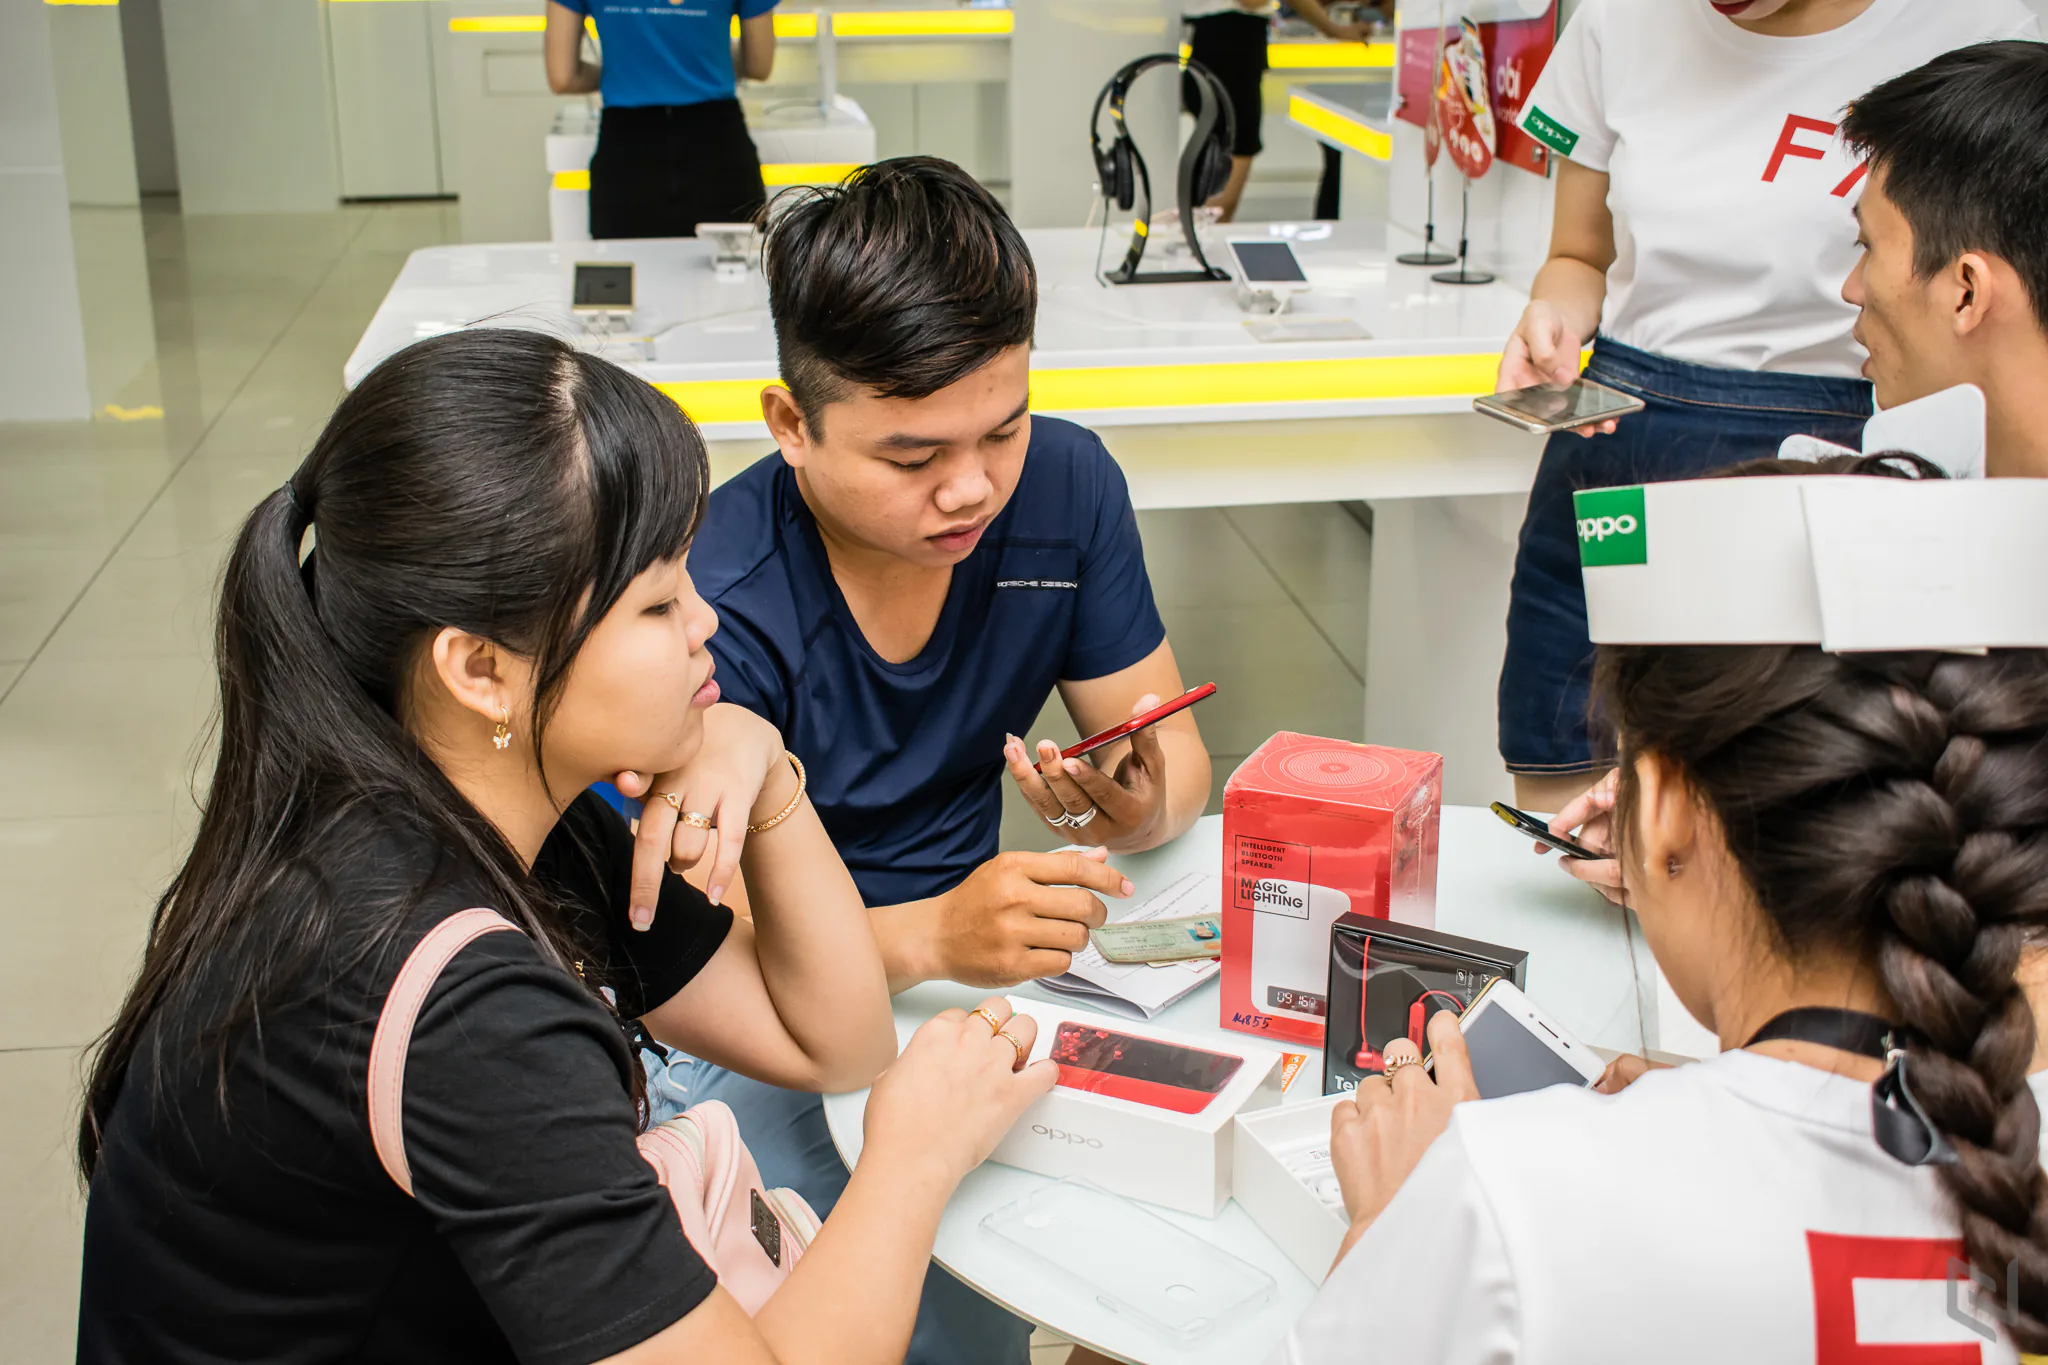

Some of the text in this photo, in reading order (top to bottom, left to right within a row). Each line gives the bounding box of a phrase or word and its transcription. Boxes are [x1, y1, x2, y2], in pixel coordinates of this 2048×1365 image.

[1496, 57, 1523, 100] obi
[1531, 116, 1571, 145] oppo
[1577, 514, 1638, 543] oppo
[1241, 841, 1286, 854] INTELLIGENT
[1241, 850, 1283, 862] BLUETOOTH
[1241, 859, 1275, 870] SPEAKER.
[1241, 877, 1288, 895] MAGIC
[1241, 889, 1303, 908] LIGHTING
[1032, 1124, 1104, 1149] oppo
